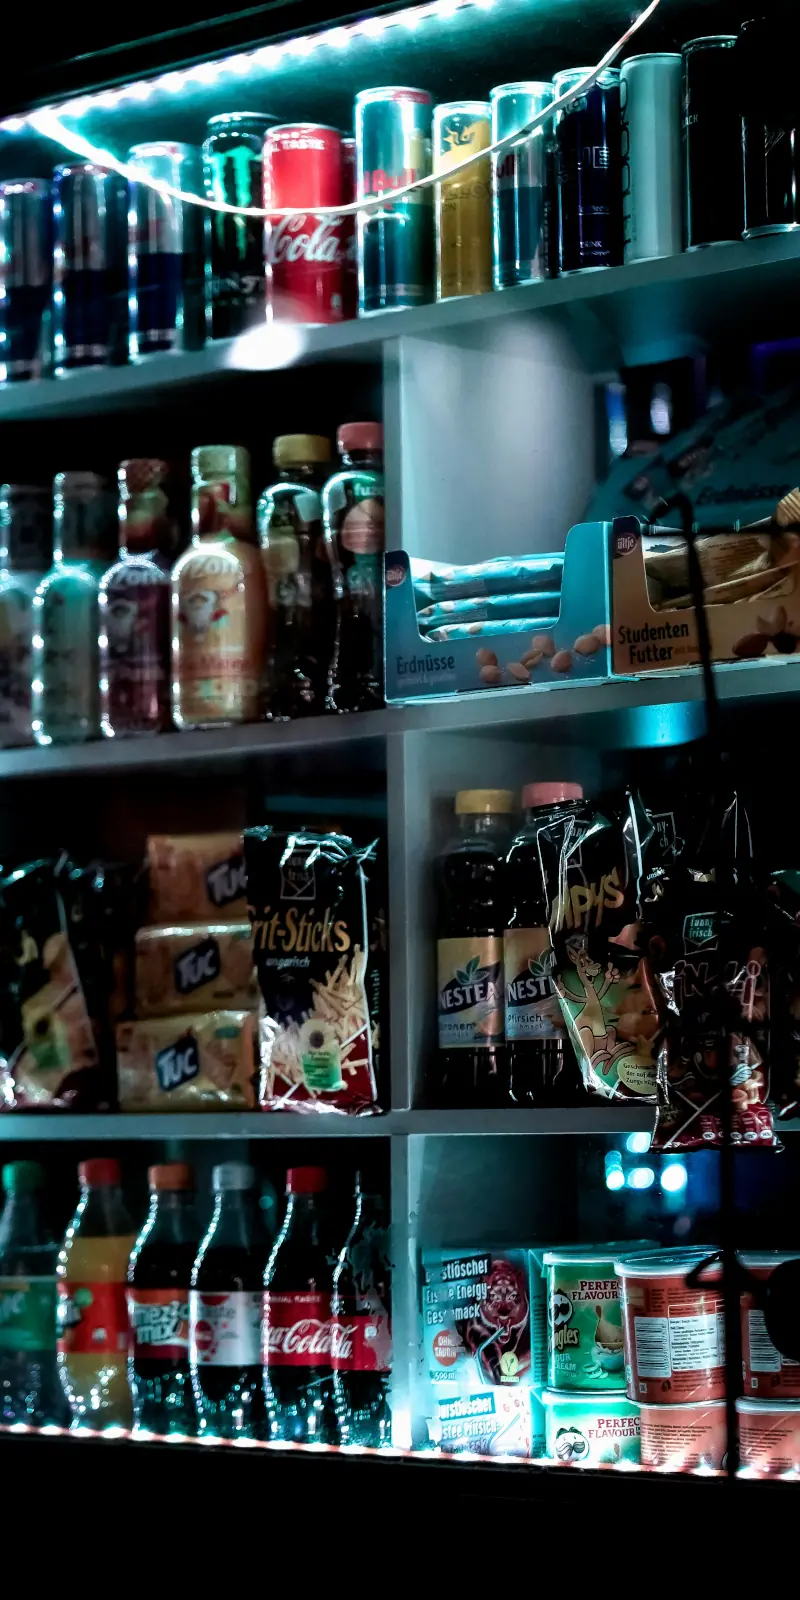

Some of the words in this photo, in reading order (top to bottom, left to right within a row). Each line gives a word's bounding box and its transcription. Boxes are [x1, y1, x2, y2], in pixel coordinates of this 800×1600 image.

[618, 622, 689, 645] Studenten
[396, 654, 455, 675] Erdnüsse
[629, 645, 675, 665] Futter
[156, 1047, 198, 1090] TUC
[572, 1291, 619, 1301] FLAVOUR
[588, 1427, 636, 1439] FLAVOUR
